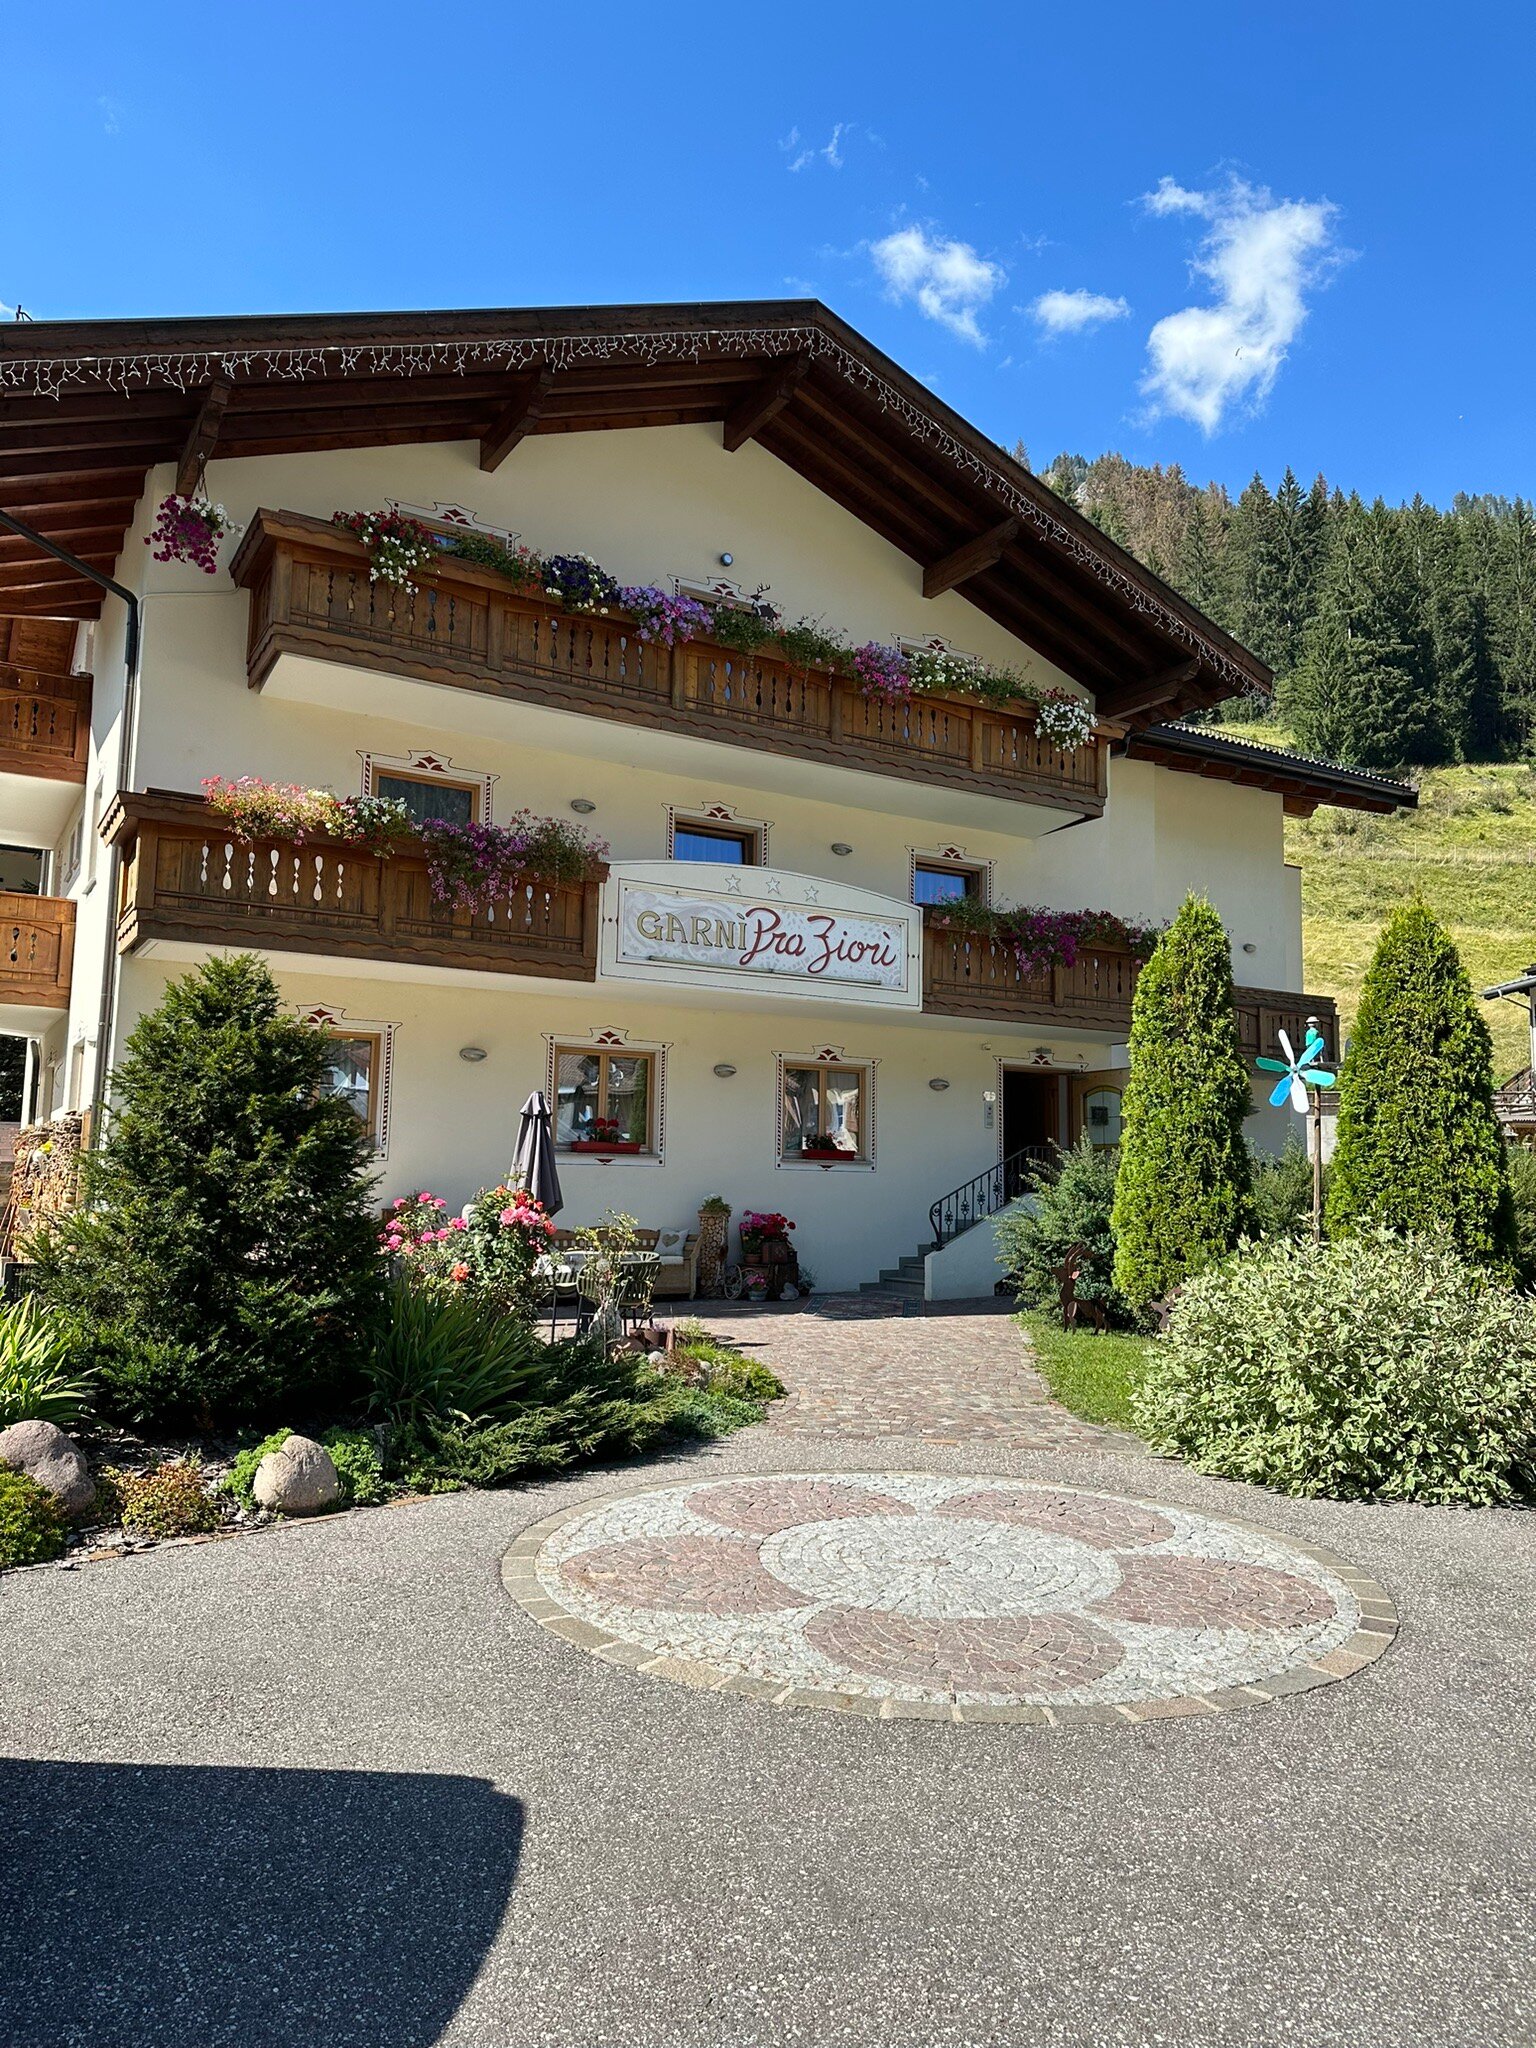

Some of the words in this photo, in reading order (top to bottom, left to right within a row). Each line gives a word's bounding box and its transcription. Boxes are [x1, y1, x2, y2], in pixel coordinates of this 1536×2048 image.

[636, 910, 747, 951] GARNÌ
[739, 907, 806, 966] Pra
[807, 915, 897, 974] Ziorì
